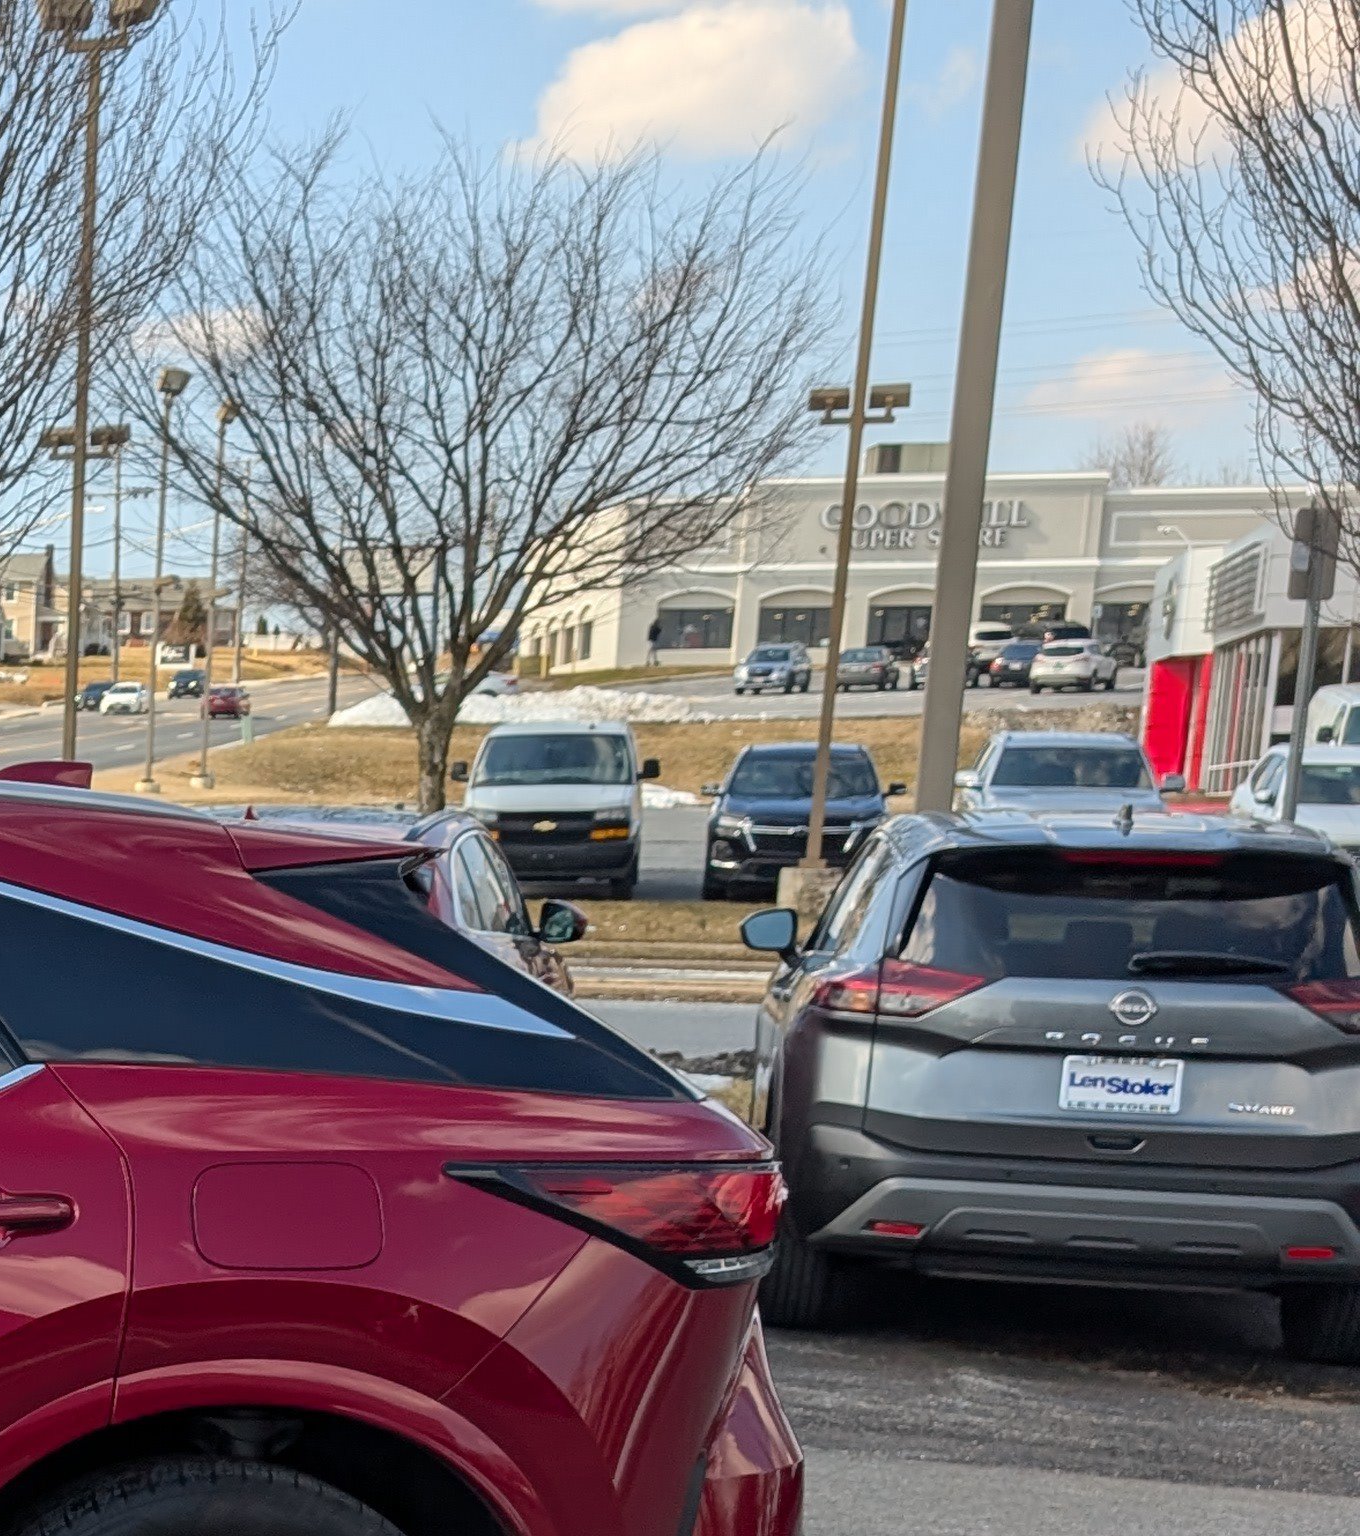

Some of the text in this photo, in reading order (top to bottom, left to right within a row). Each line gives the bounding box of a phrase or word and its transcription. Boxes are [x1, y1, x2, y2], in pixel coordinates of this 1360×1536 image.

[821, 500, 1027, 529] GOODLL
[851, 528, 1008, 550] UPER SRE
